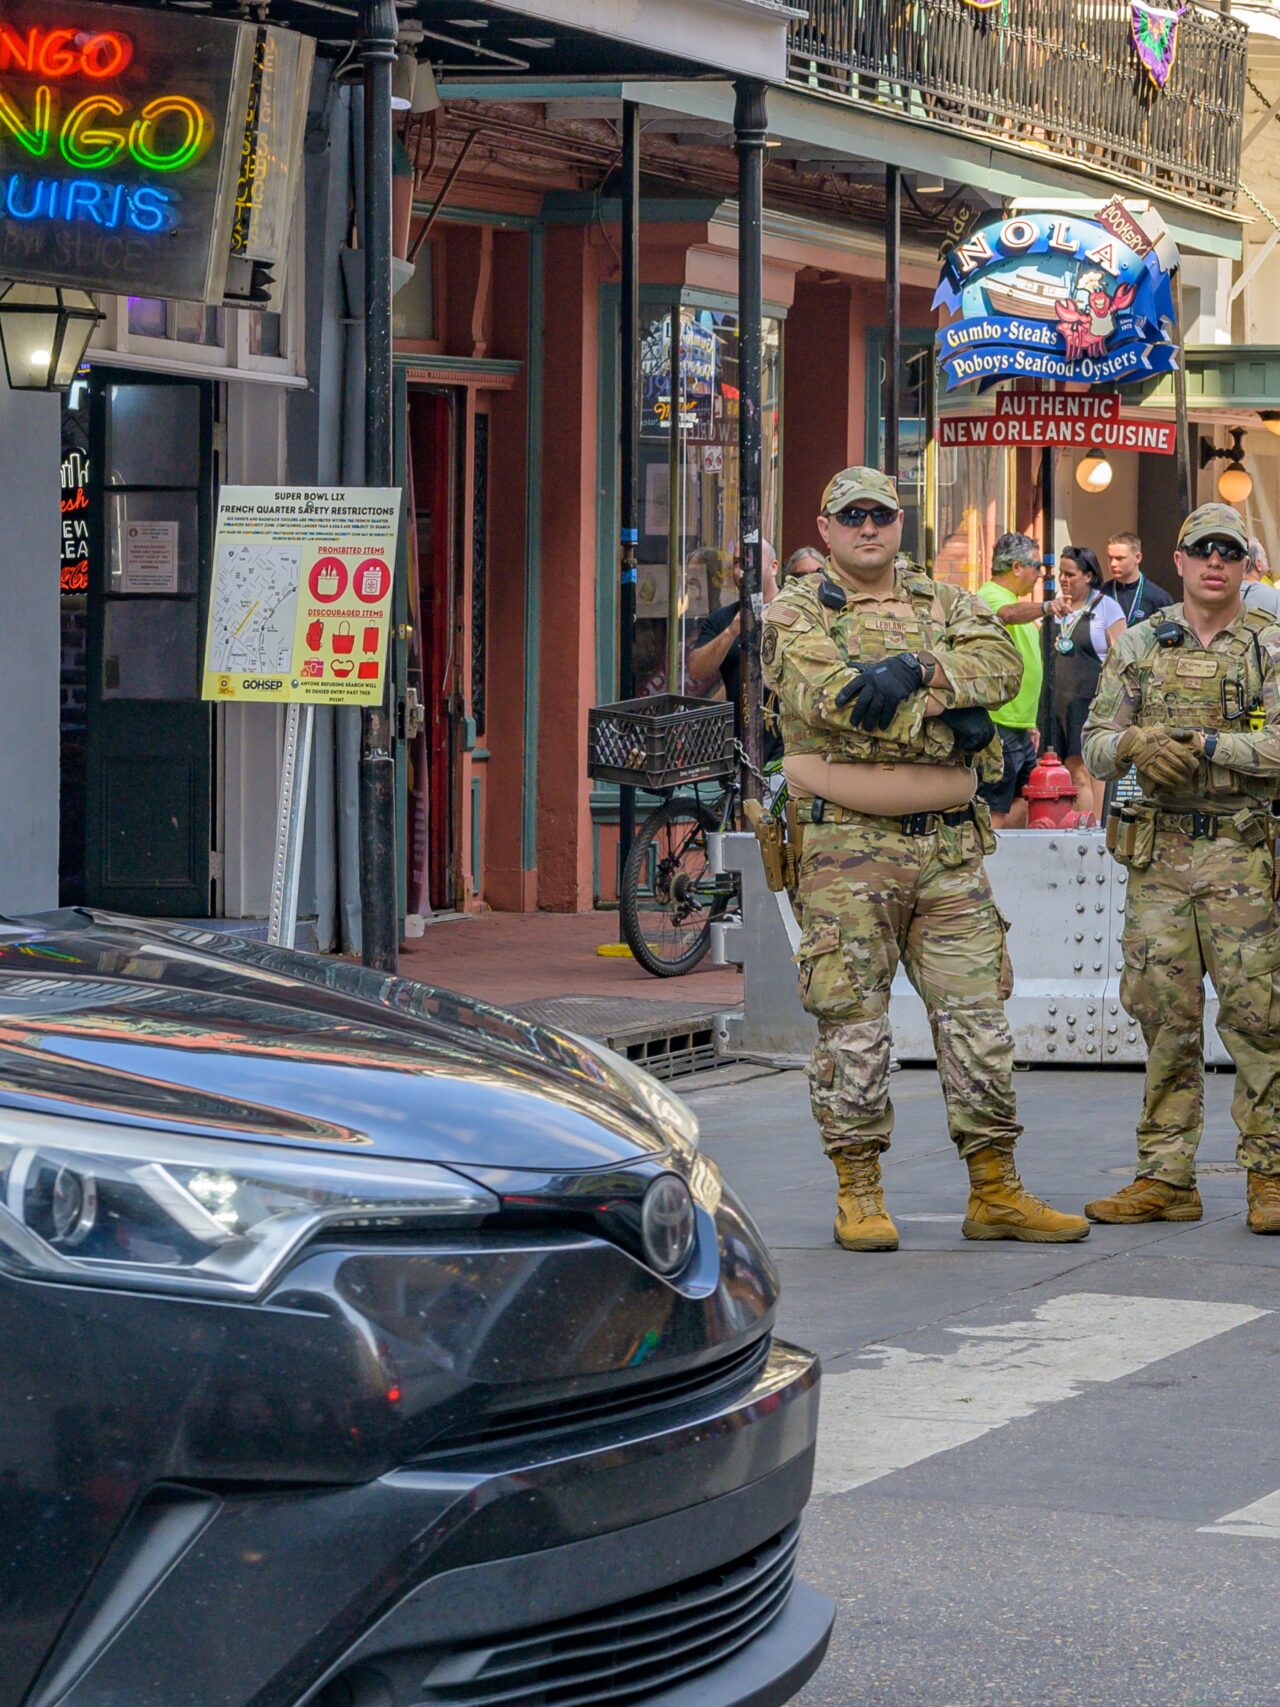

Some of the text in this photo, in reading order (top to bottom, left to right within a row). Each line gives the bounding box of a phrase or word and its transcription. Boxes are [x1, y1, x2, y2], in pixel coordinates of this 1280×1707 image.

[1101, 206, 1147, 252] COOKERY
[955, 219, 1121, 277] NOLA
[946, 321, 1058, 347] Gumbo Steaks
[953, 350, 1138, 381] Poboys Seafood Oysters
[1001, 396, 1114, 418] AUTHENTIC
[943, 420, 1170, 449] NEW ORLEANS CUISINE
[274, 492, 345, 501] SUPER BOWL LIX
[220, 505, 395, 516] FRENCH QUARTER SAFETY RESTRICTIONS
[318, 546, 362, 554] PROHIBITED
[875, 620, 907, 630] LEBLANC
[242, 679, 283, 690] GOHSEP
